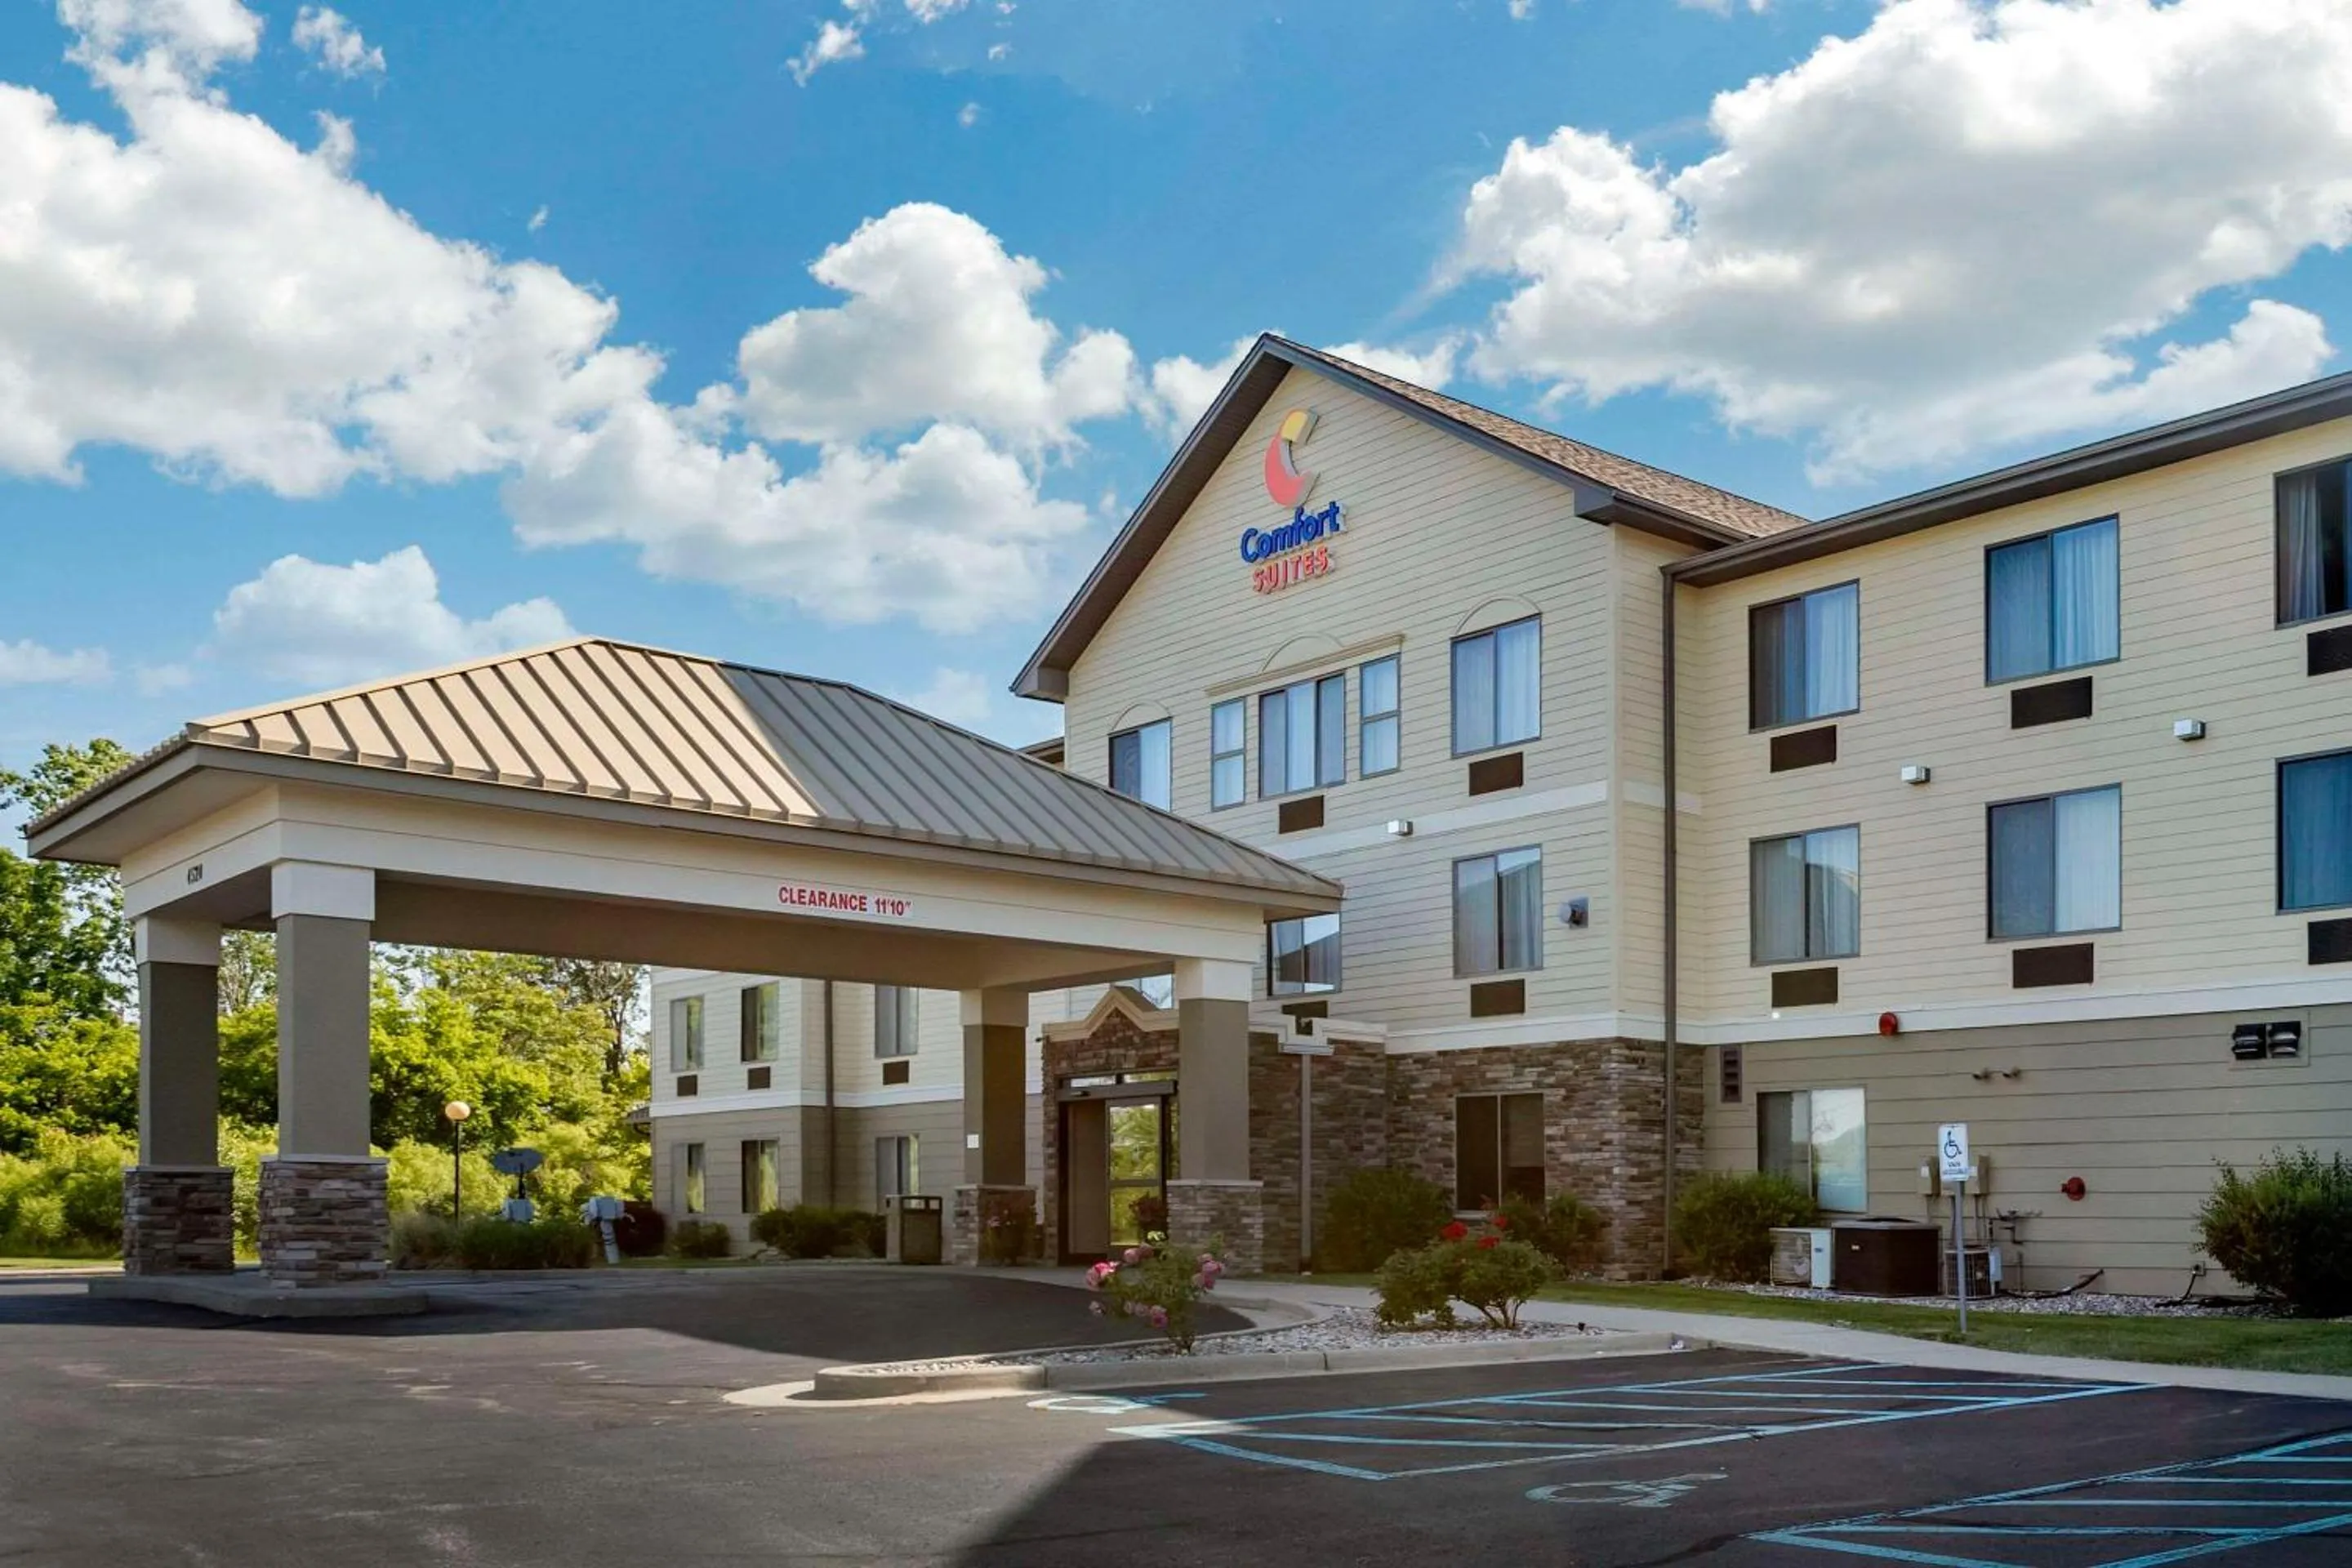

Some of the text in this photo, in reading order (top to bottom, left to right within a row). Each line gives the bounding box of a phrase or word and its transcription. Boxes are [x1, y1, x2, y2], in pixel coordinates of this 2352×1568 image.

[1241, 501, 1343, 564] Comfort
[1252, 545, 1332, 594] SUITES
[778, 886, 868, 911] CLEARANCE
